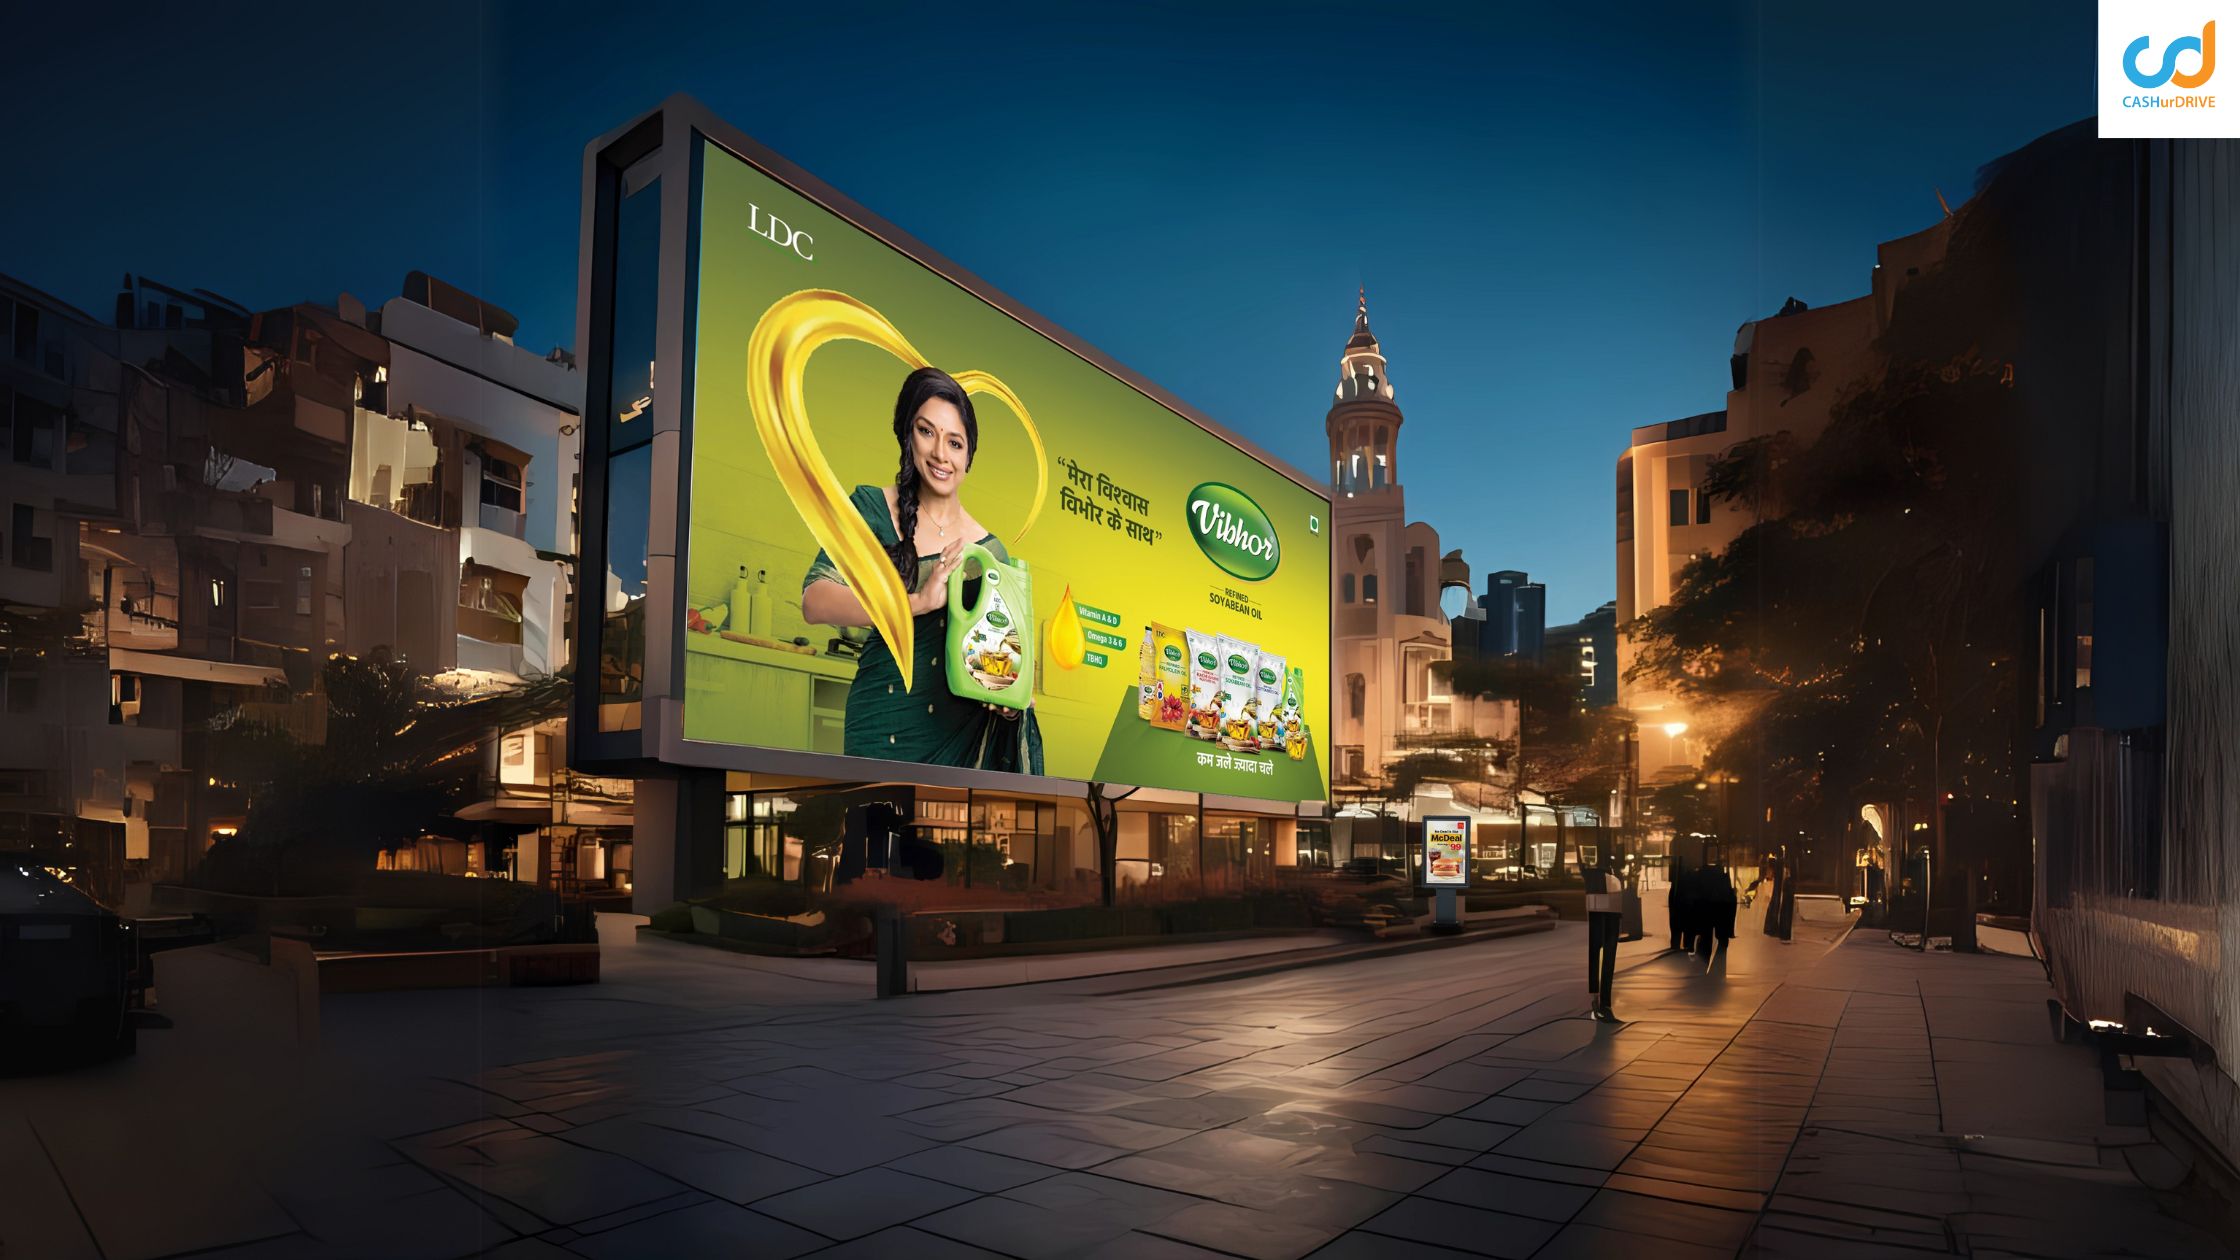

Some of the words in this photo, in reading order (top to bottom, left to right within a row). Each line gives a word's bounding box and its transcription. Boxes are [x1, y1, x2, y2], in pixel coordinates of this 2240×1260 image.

[747, 202, 814, 261] LDC
[1096, 472, 1150, 516] विश्वास
[1060, 486, 1104, 525] विभोर
[1106, 508, 1122, 530] के
[1192, 500, 1274, 560] Vibhor
[1209, 592, 1250, 616] SOYABEAN
[1251, 608, 1262, 620] OIL
[1224, 588, 1248, 603] REFINED
[1078, 606, 1100, 620] Vitamin
[1102, 613, 1106, 622] A
[1088, 631, 1107, 644] Omega
[1086, 653, 1102, 664] TBHQ
[1196, 752, 1214, 767] कम
[1216, 753, 1232, 769] जले
[1259, 760, 1273, 775] चले
